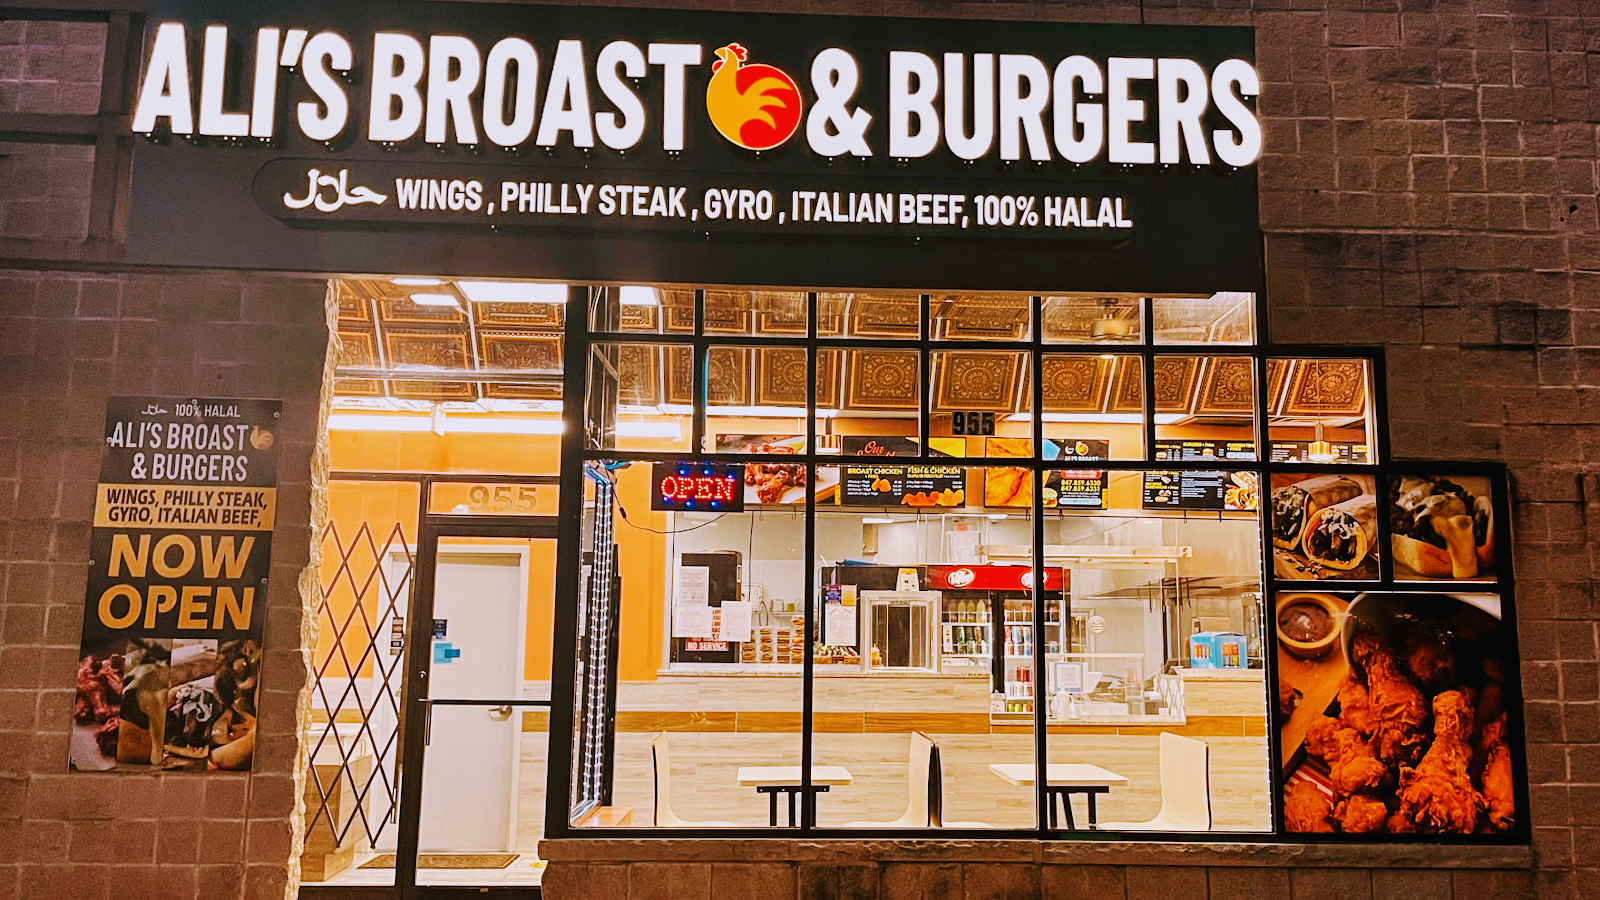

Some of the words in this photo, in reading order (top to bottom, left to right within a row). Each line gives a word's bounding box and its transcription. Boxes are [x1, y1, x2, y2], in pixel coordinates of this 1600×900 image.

[131, 22, 353, 142] ALI'S
[367, 32, 702, 151] BROAST
[805, 47, 873, 159] &
[888, 50, 1263, 168] BURGERS
[500, 181, 597, 215] PHILLY
[791, 191, 894, 225] ITALIAN
[899, 193, 969, 229] BEEF,
[974, 194, 1038, 227] 100%
[1044, 196, 1132, 229] HALAL
[175, 403, 202, 418] 100%
[204, 404, 241, 418] HALAL
[953, 411, 994, 436] 955
[110, 421, 163, 449] ALI'S
[166, 422, 249, 451] BROAST
[131, 452, 148, 480] &
[152, 453, 248, 482] BURGERS
[847, 467, 873, 475] BROAST
[907, 466, 923, 474] FISH
[930, 467, 961, 475] CHICKEN
[106, 488, 160, 507] WINGS,
[163, 489, 214, 507] PHILLY
[217, 491, 268, 510] STEAK,
[468, 485, 537, 513] 955
[660, 475, 735, 501] OPEN
[108, 506, 154, 526] GYRO,
[157, 508, 218, 525] ITALIAN
[221, 509, 262, 528] BEEF,
[107, 534, 256, 579] NOW
[98, 584, 255, 631] OPEN
[687, 641, 698, 650] NO
[698, 641, 727, 650] SERVICE
